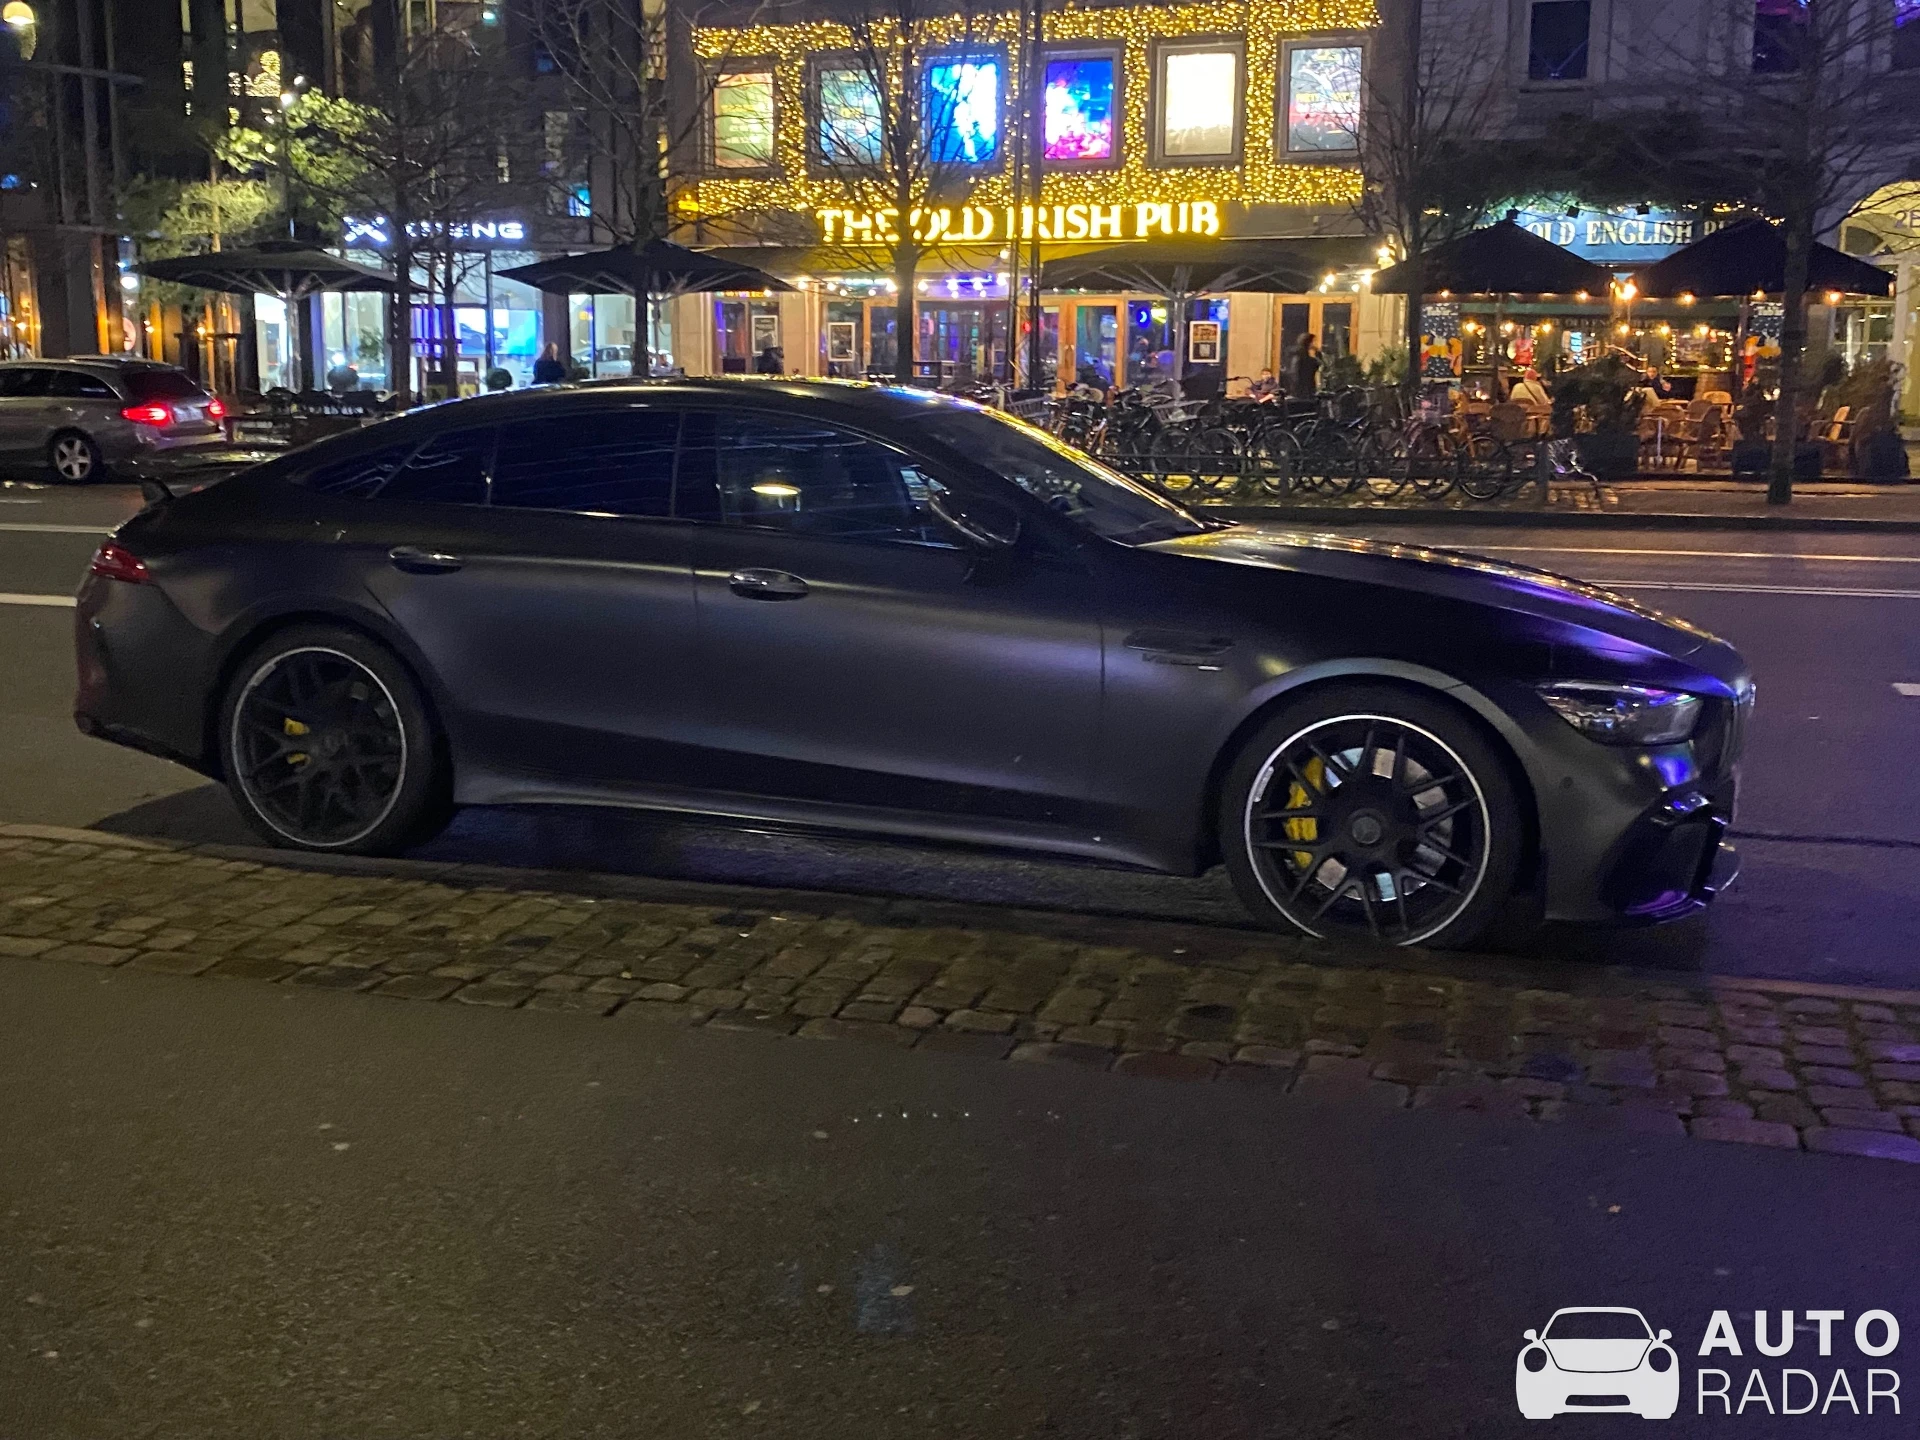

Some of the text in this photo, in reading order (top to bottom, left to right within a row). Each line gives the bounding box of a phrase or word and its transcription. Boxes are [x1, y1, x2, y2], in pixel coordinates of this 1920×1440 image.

[816, 200, 1220, 243] THE OLD IRISH PUB
[1585, 219, 1693, 246] ENGLISH
